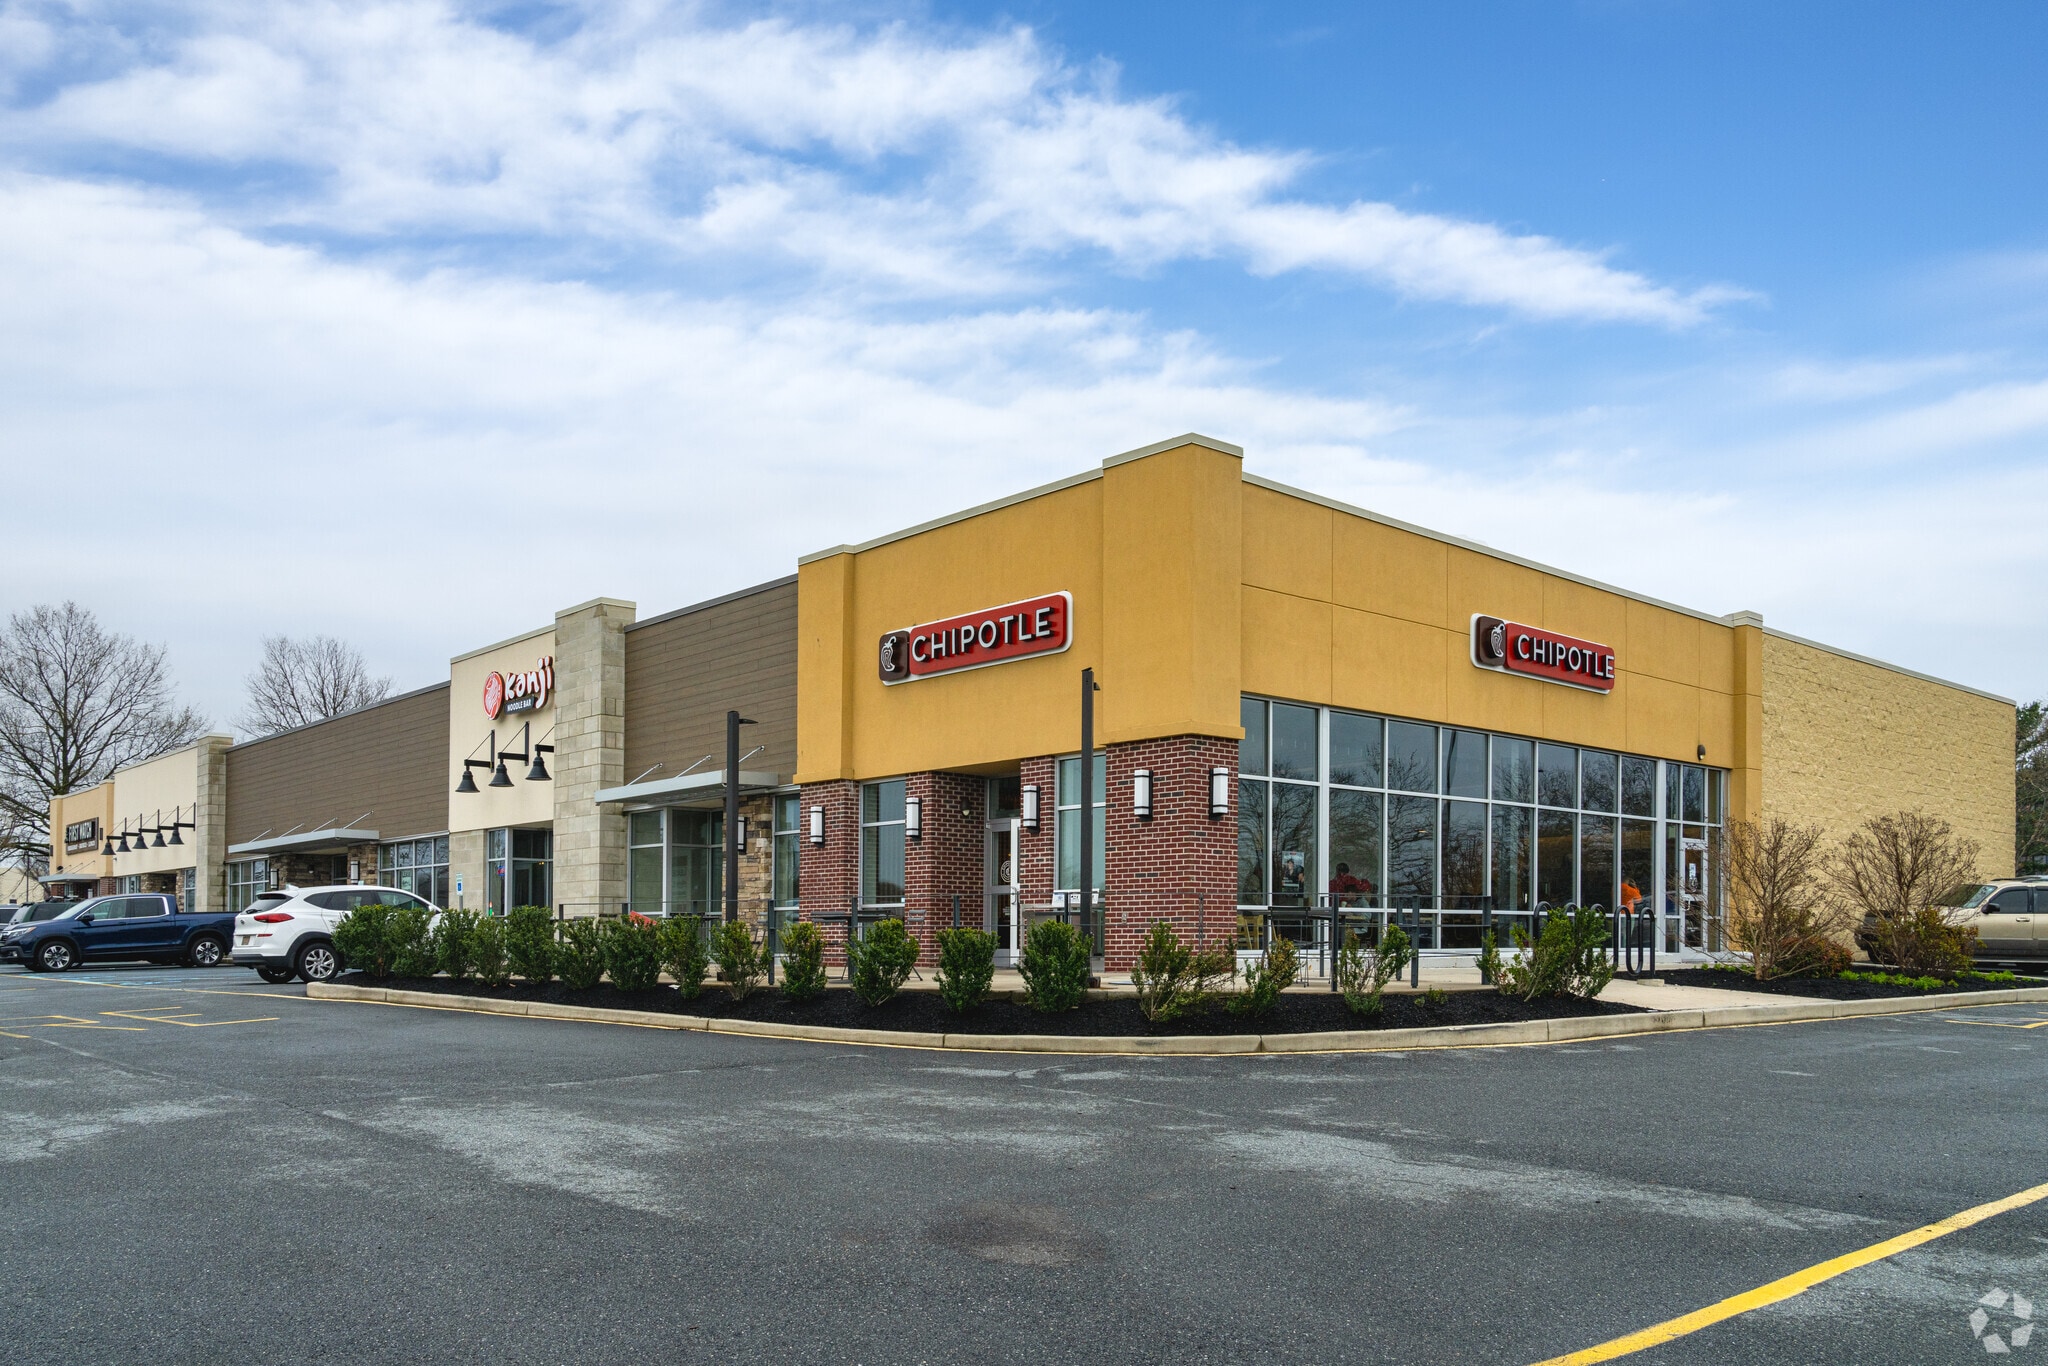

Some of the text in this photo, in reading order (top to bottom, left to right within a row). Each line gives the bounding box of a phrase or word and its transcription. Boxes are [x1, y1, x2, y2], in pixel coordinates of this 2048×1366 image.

[911, 606, 1053, 662] CHIPOTLE
[1516, 634, 1615, 679] CHIPOTLE
[507, 698, 532, 712] NOODLE BAR
